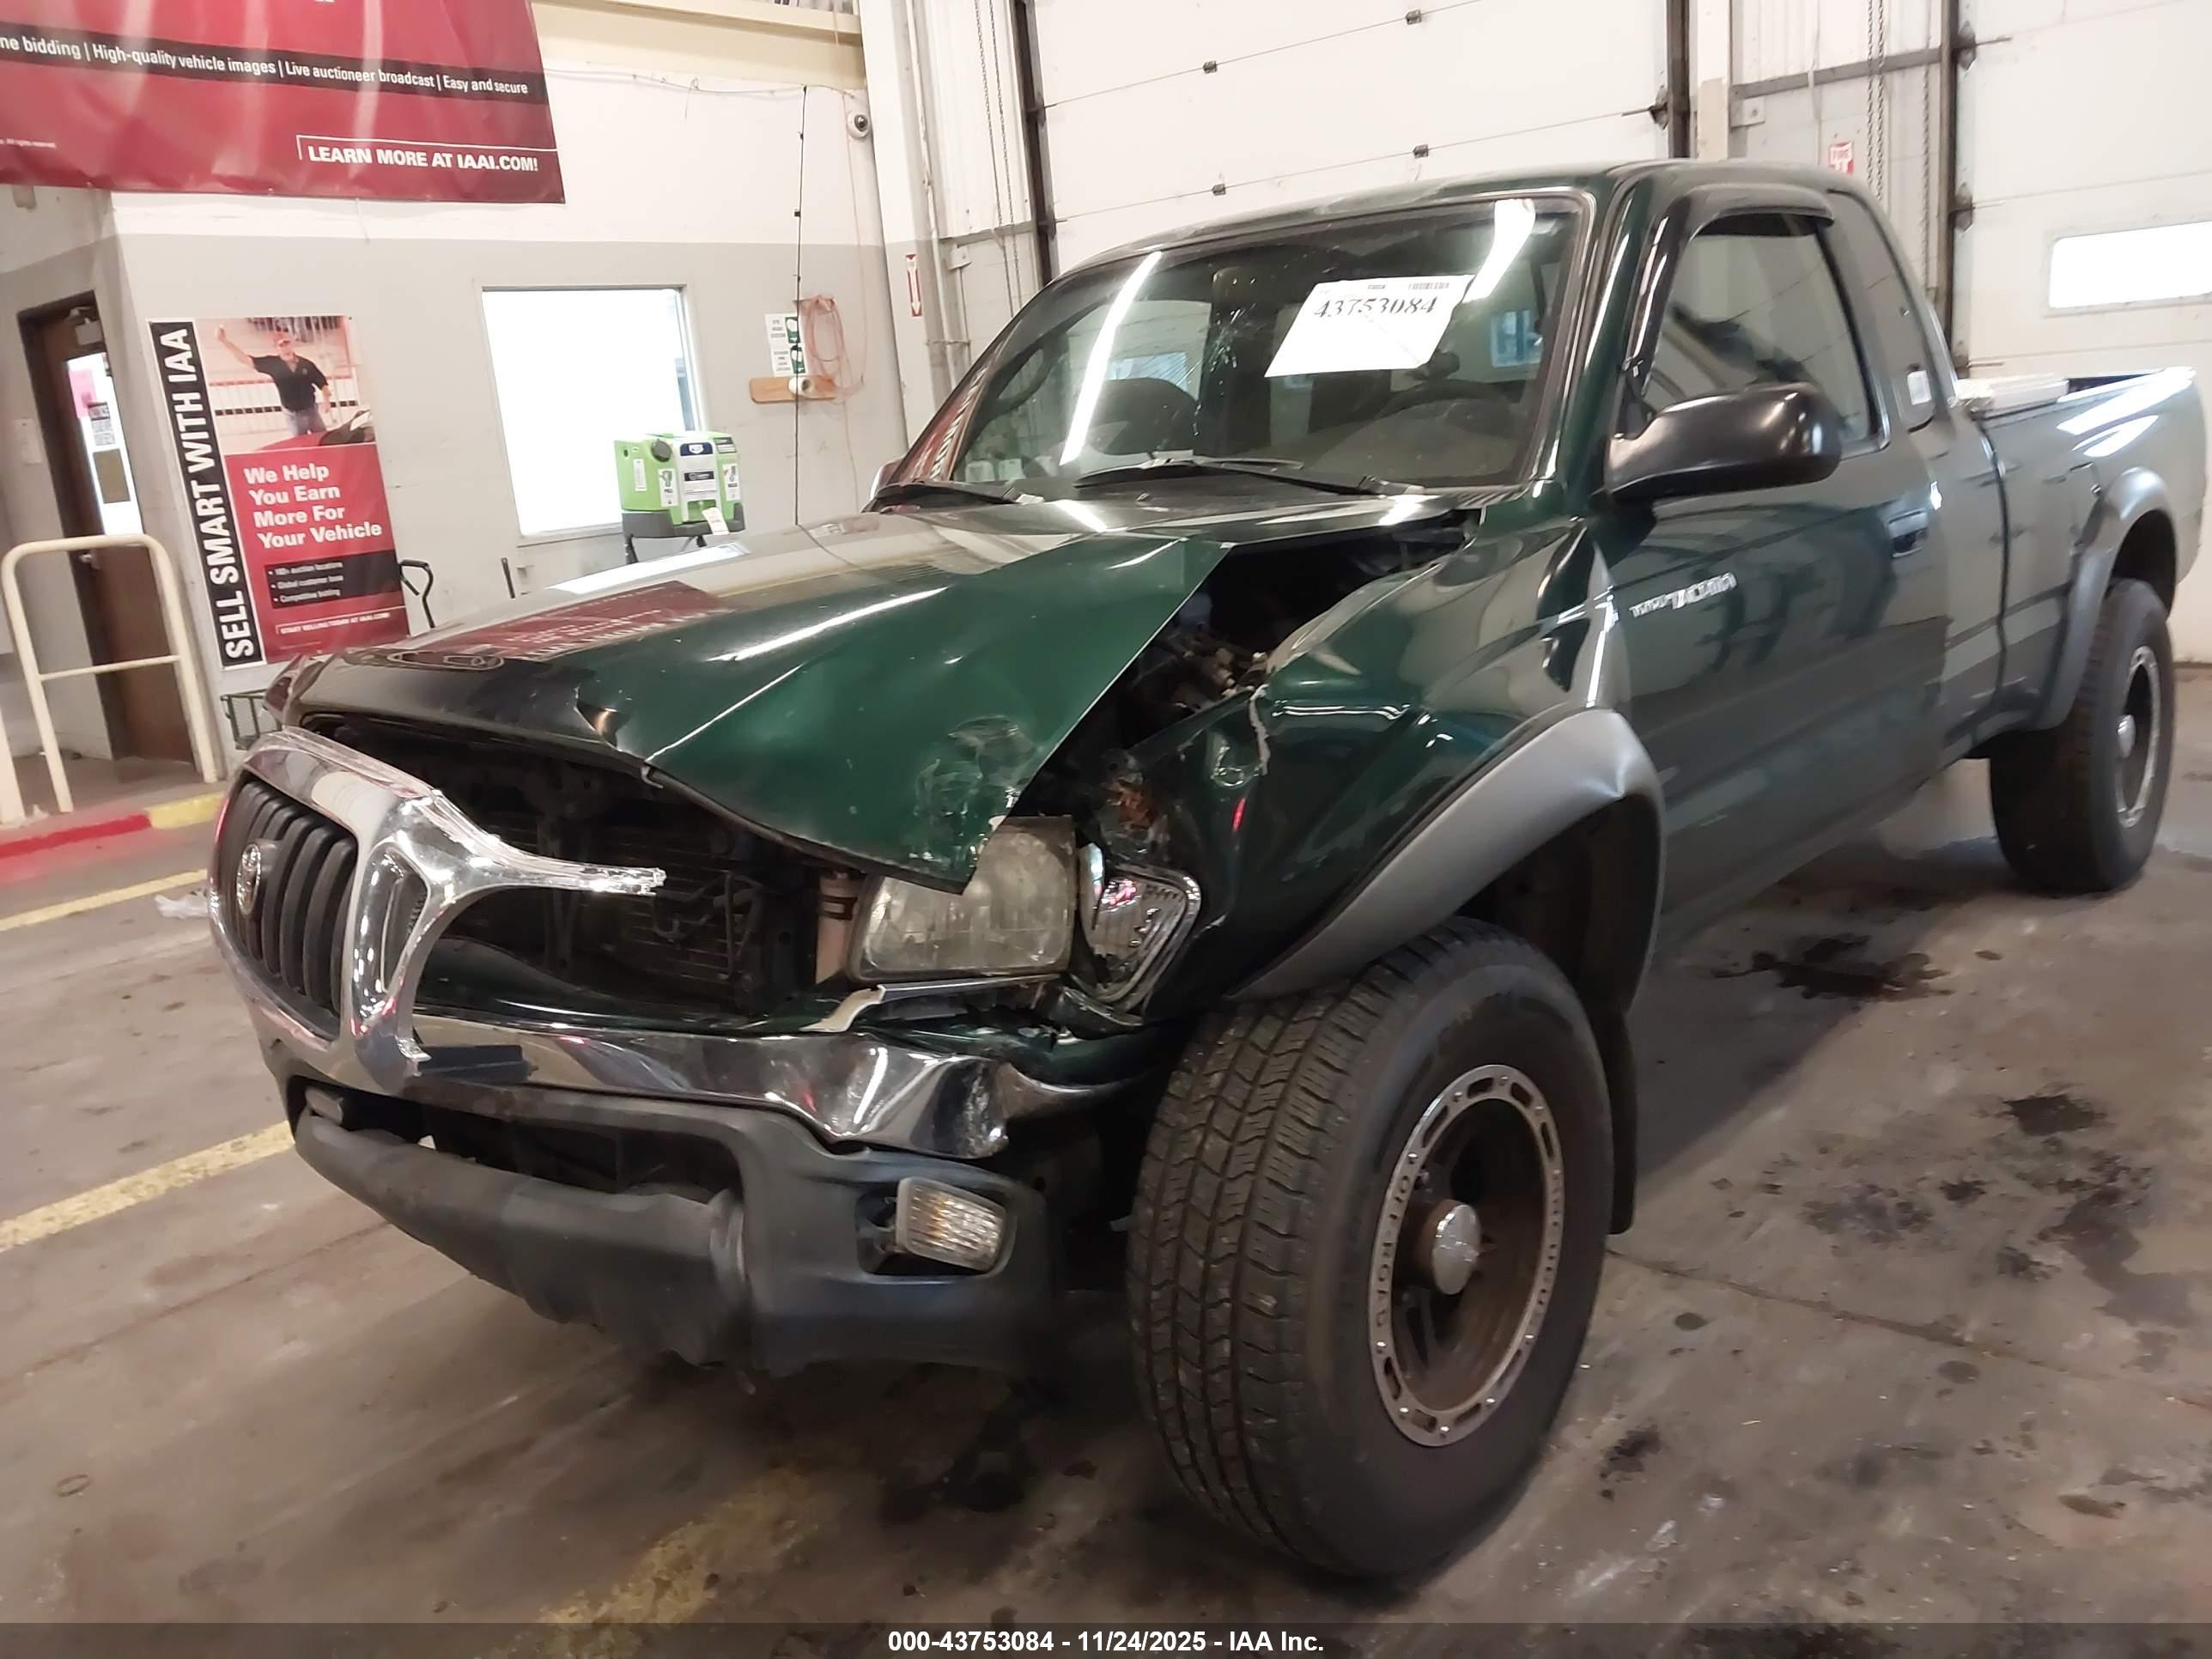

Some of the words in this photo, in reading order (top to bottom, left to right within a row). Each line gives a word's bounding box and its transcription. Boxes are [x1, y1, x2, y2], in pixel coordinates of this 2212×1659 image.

[22, 36, 82, 59] bidding
[92, 43, 177, 69] High-quality
[178, 54, 225, 70] vehicle
[227, 57, 276, 76] images
[285, 61, 310, 76] Live
[313, 66, 375, 82] auctioneer
[378, 69, 435, 87] broadcast
[442, 75, 468, 92] Easy
[471, 78, 493, 91] and
[494, 81, 528, 94] secure
[307, 146, 372, 164] LEARN
[376, 149, 428, 167] MORE
[431, 153, 454, 168] AT
[457, 154, 538, 172] IAAI.COM!
[1314, 296, 1438, 318] 43753084
[160, 328, 198, 382] IAA
[172, 392, 215, 473] WITH
[244, 467, 277, 484] We
[282, 463, 330, 482] Help
[248, 489, 289, 506] You
[294, 484, 341, 502] Earn
[253, 510, 307, 528] More
[312, 505, 345, 522] For
[191, 480, 240, 585] SMART
[257, 532, 306, 550] Your
[309, 521, 382, 543] Vehicle
[216, 591, 254, 659] SELL
